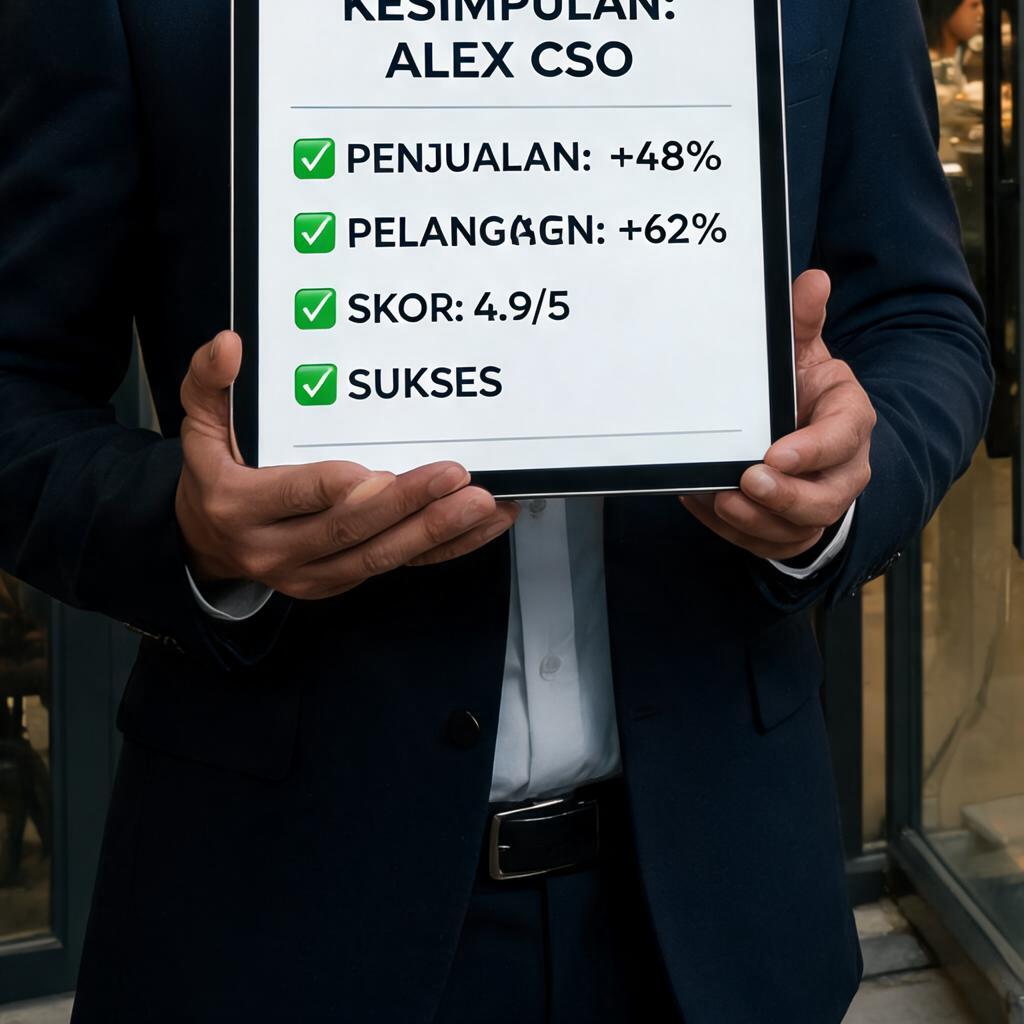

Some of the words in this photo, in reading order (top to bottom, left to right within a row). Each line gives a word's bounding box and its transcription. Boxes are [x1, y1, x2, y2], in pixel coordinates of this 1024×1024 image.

[385, 41, 515, 79] ALEX
[530, 40, 634, 78] CSO
[347, 141, 592, 174] PENJUALAN:
[610, 140, 723, 173] +48%
[618, 212, 728, 245] +62%
[348, 292, 465, 324] SKOR:
[473, 287, 571, 326] 4.9/5
[348, 365, 504, 400] SUKSES
